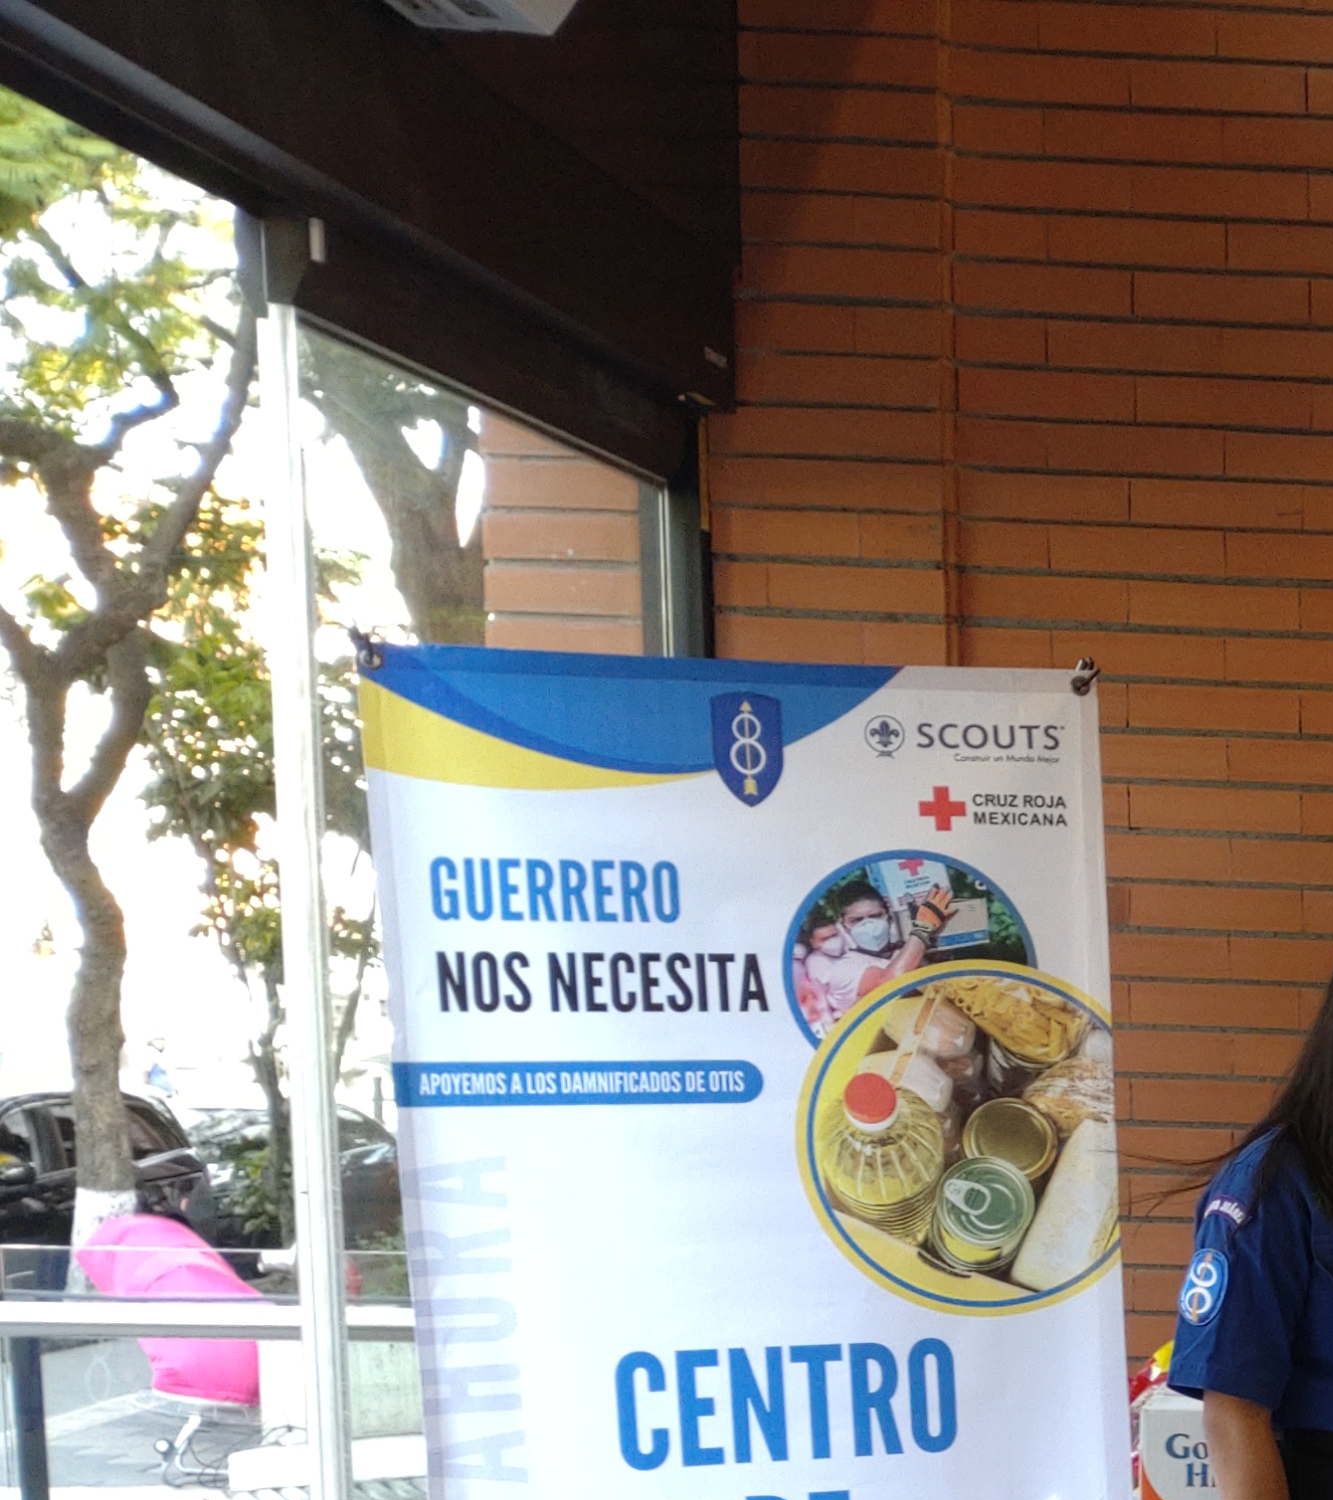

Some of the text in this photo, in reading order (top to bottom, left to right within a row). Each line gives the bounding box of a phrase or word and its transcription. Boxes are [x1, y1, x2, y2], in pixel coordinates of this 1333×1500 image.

[916, 723, 1060, 750] SCOUTS
[972, 794, 1067, 809] CRUZ ROJA
[973, 812, 1068, 827] MEXICANA
[429, 856, 681, 924] GUERRERO
[436, 951, 770, 1013] NOS NECESITA
[419, 1070, 746, 1096] APOYEMOS A LOS DAMNIFICADOS DE OTIS
[614, 1337, 959, 1472] CENTRO
